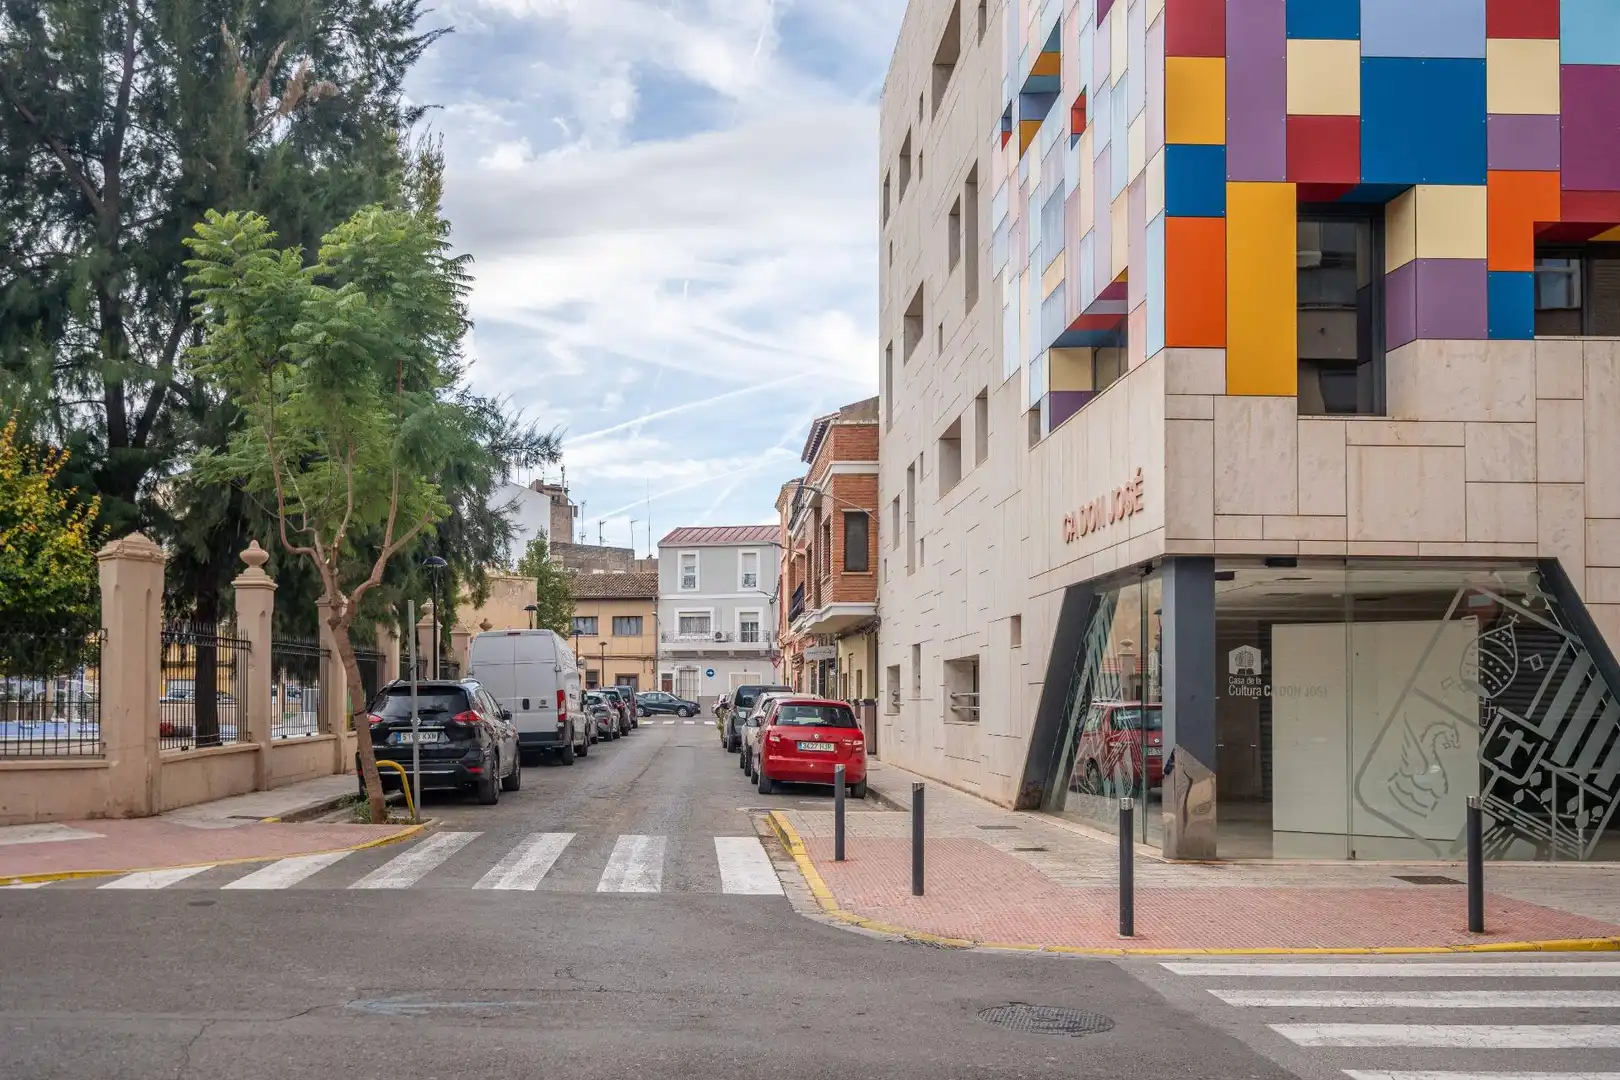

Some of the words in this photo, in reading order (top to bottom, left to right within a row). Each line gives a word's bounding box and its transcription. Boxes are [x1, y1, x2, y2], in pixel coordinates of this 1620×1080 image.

[1063, 512, 1079, 544] CA
[1079, 493, 1105, 537] DON
[1108, 466, 1143, 525] JOSÉ
[1228, 675, 1245, 685] Casa
[1246, 676, 1255, 685] de
[1255, 676, 1262, 685] la
[1228, 684, 1262, 696] Cultura
[1279, 685, 1302, 697] DON
